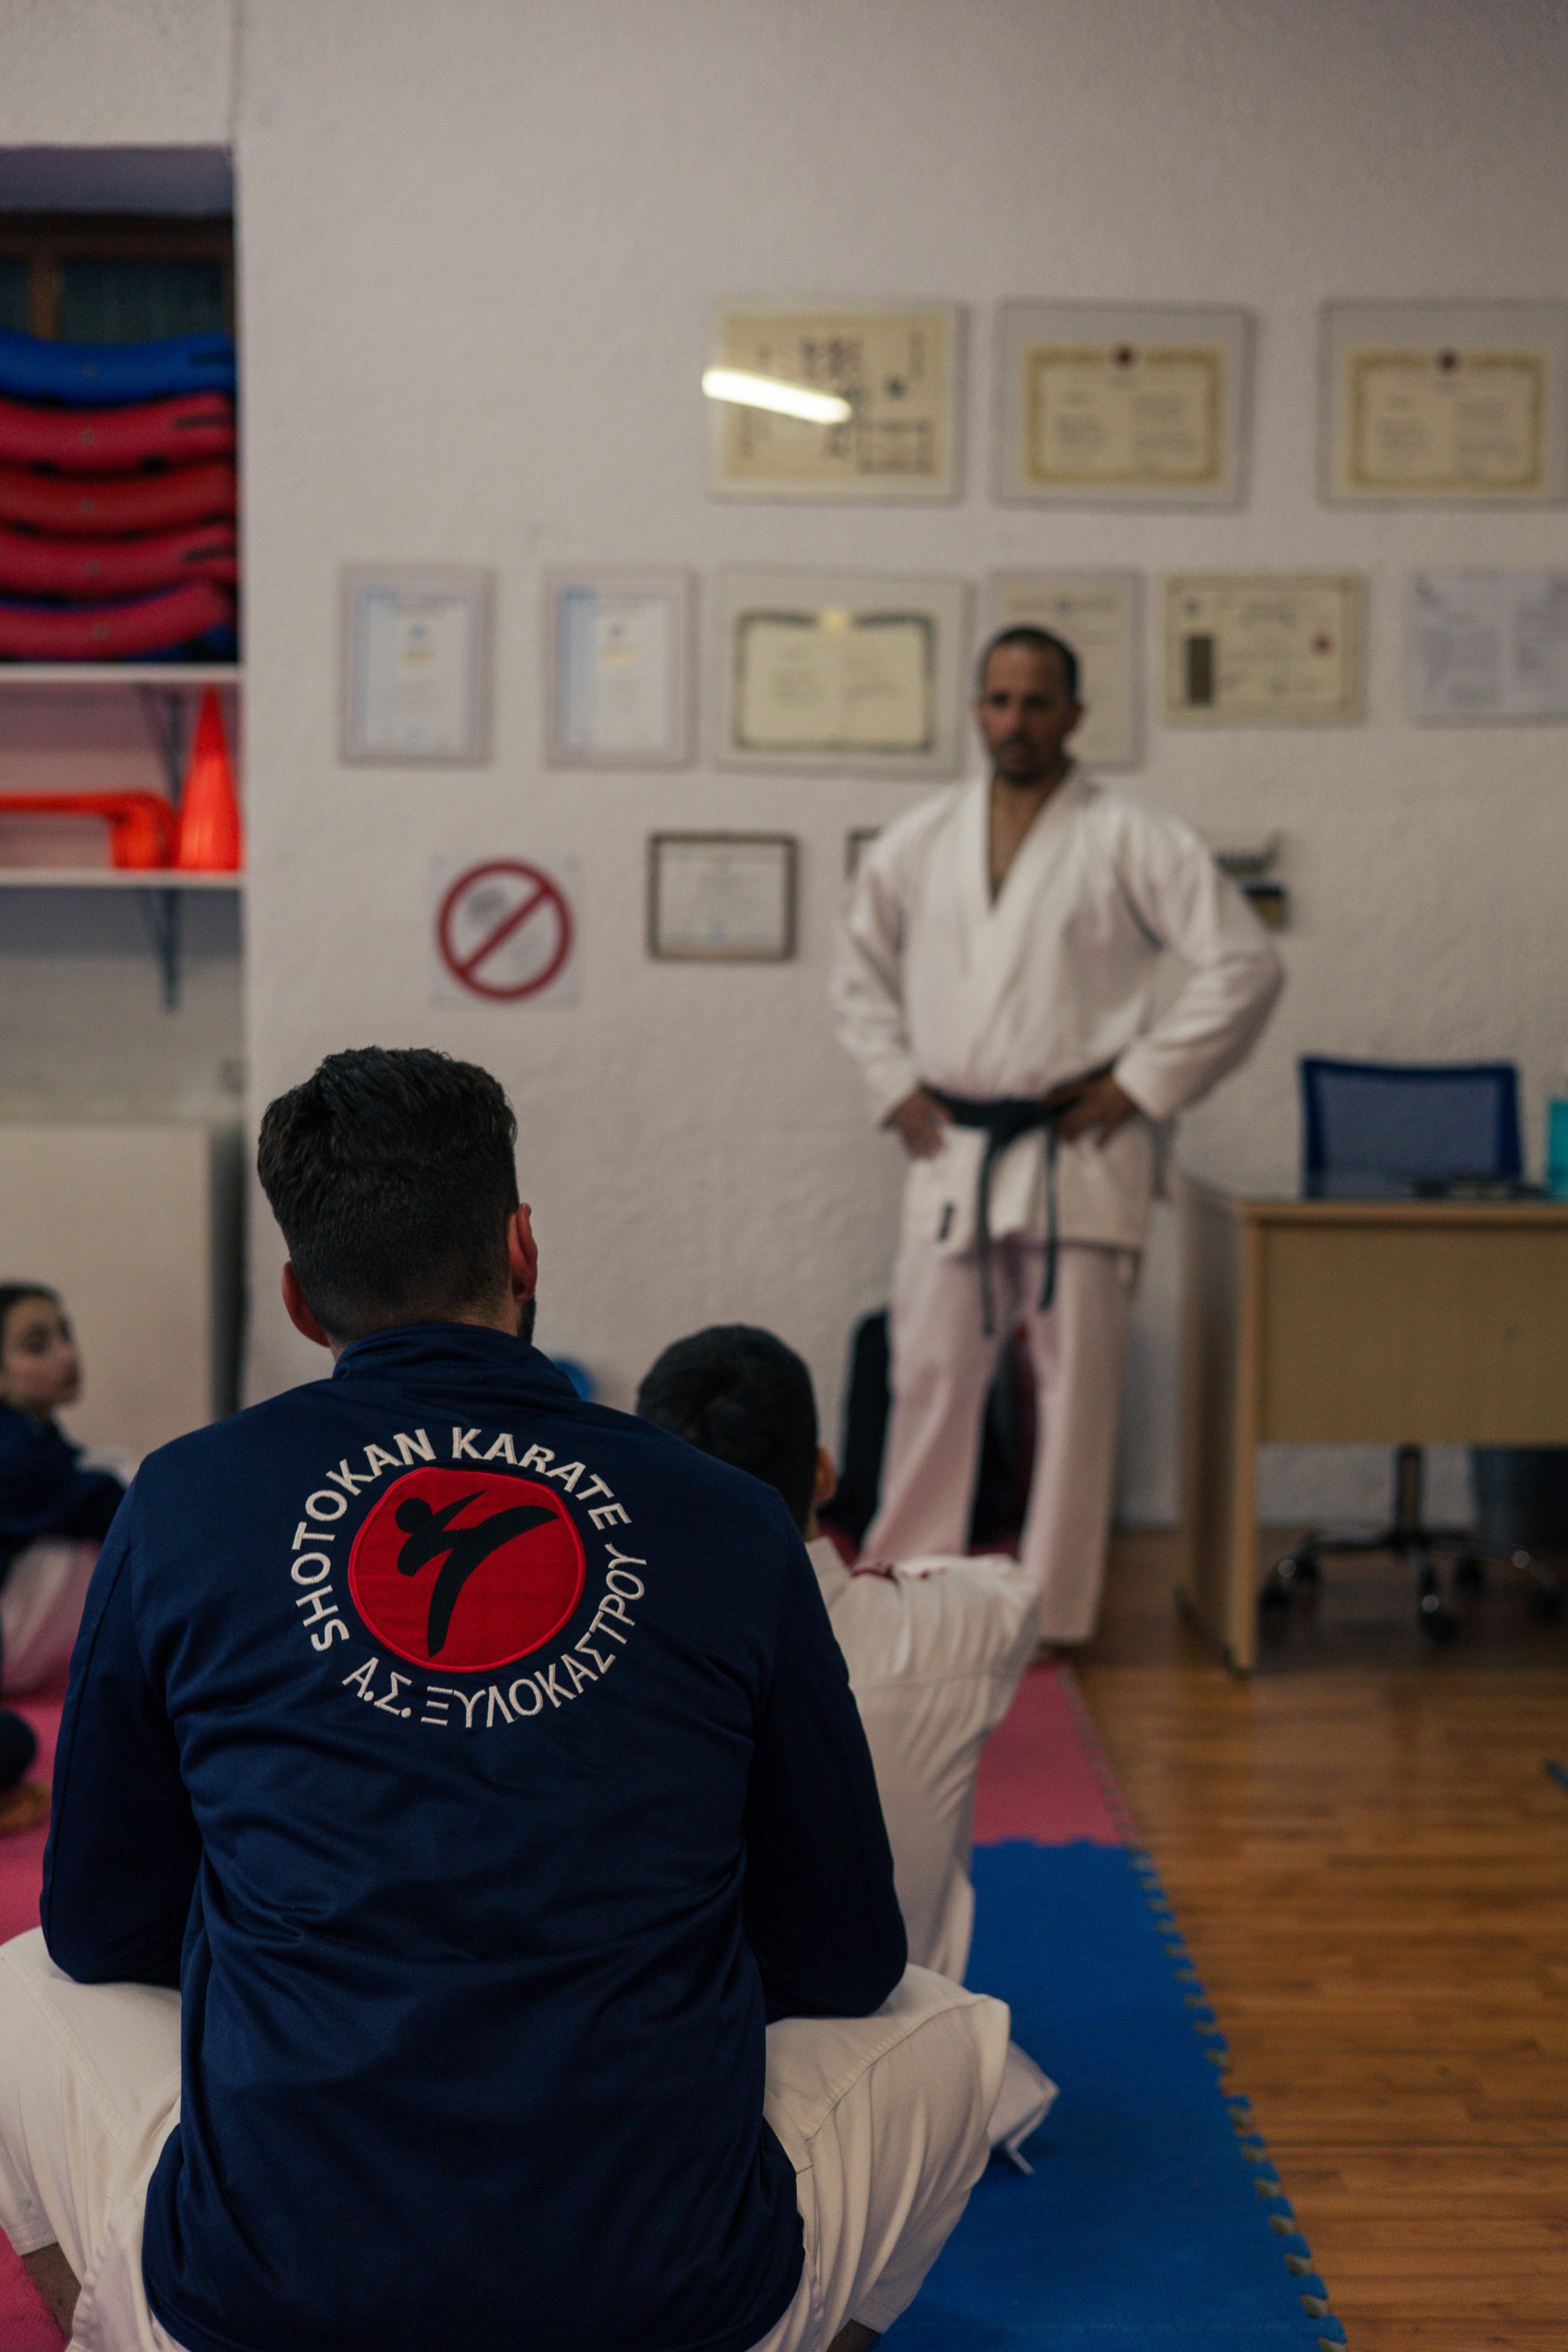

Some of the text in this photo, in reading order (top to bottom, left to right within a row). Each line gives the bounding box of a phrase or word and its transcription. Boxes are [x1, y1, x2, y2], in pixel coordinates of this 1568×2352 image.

[291, 1426, 632, 1651] SHOTOKAN KARATE
[342, 1543, 647, 1728] Α.Σ. ΞΥΛΟΚΑΣΤΡΟΥ
